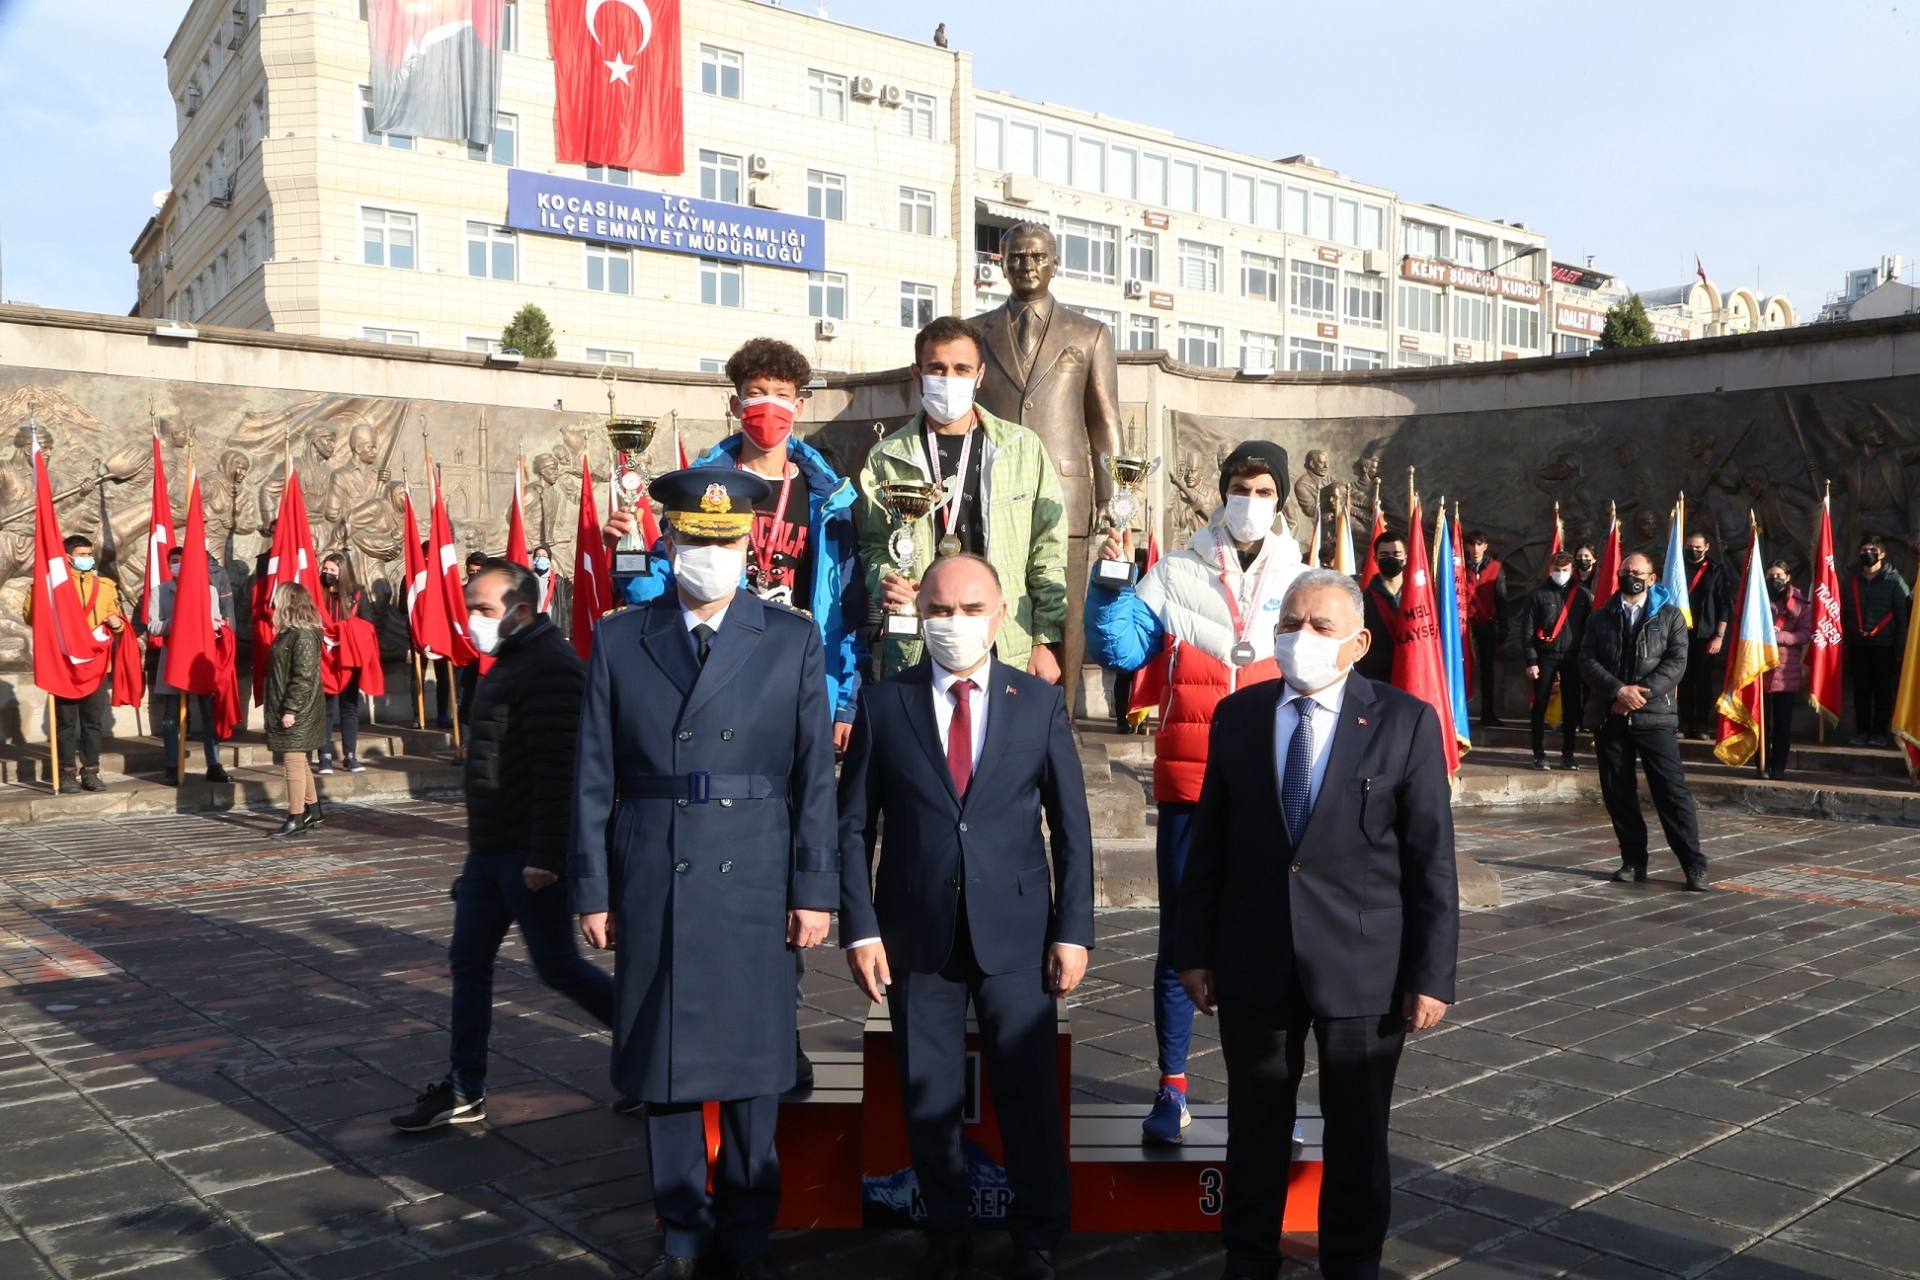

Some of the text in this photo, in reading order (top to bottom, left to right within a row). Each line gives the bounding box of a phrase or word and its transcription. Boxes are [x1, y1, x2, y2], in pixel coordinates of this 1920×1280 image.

[537, 192, 805, 248] KOCASİNAN KAYMAKAMLIĞI
[661, 195, 695, 214] T.C.
[541, 208, 803, 263] İLÇE EMNİYET MÜDÜRLÜĞÜ
[1410, 260, 1541, 300] KENT SÜRÜCÜ KURSU
[1558, 308, 1606, 333] ADALET BİN
[1654, 324, 1683, 337] EMLAK
[1198, 1167, 1224, 1216] 3
